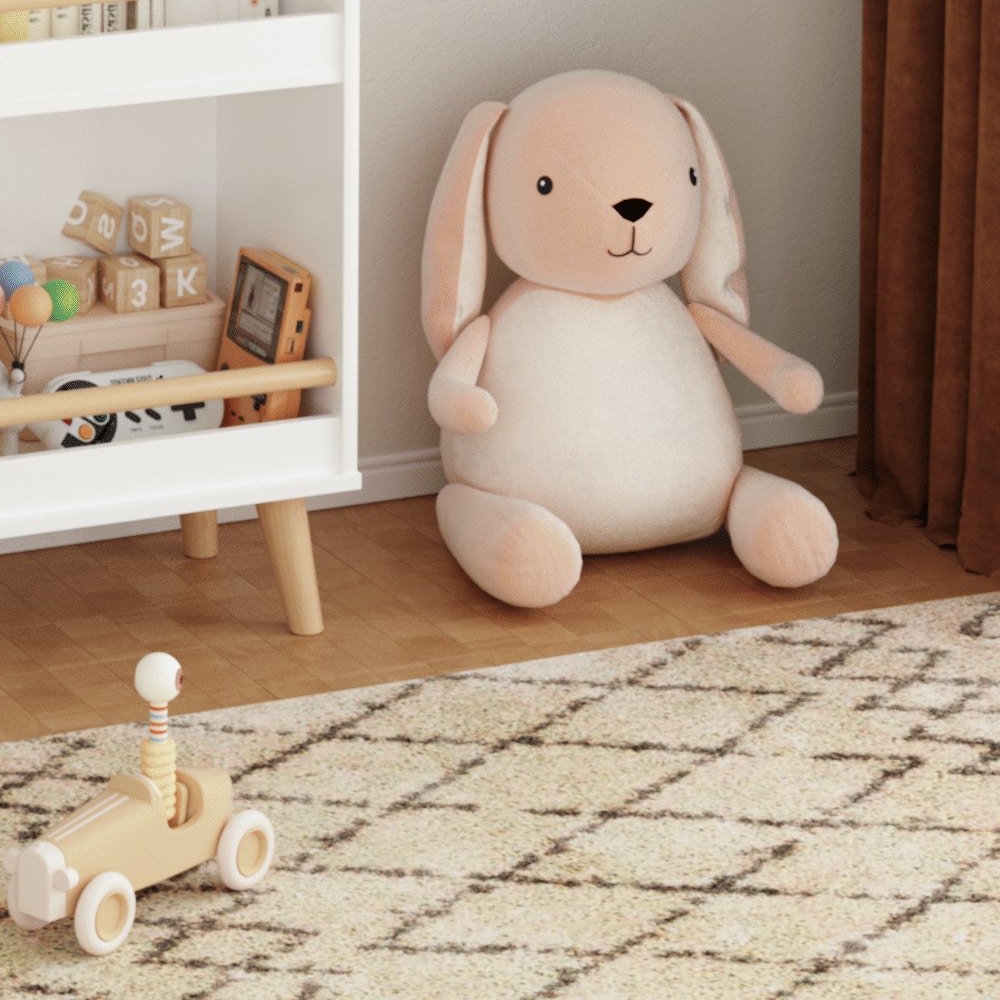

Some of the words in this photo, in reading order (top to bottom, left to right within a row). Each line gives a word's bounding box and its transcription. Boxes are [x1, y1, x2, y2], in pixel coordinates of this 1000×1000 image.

[160, 216, 185, 253] W
[130, 278, 148, 308] 3
[177, 267, 198, 297] K
